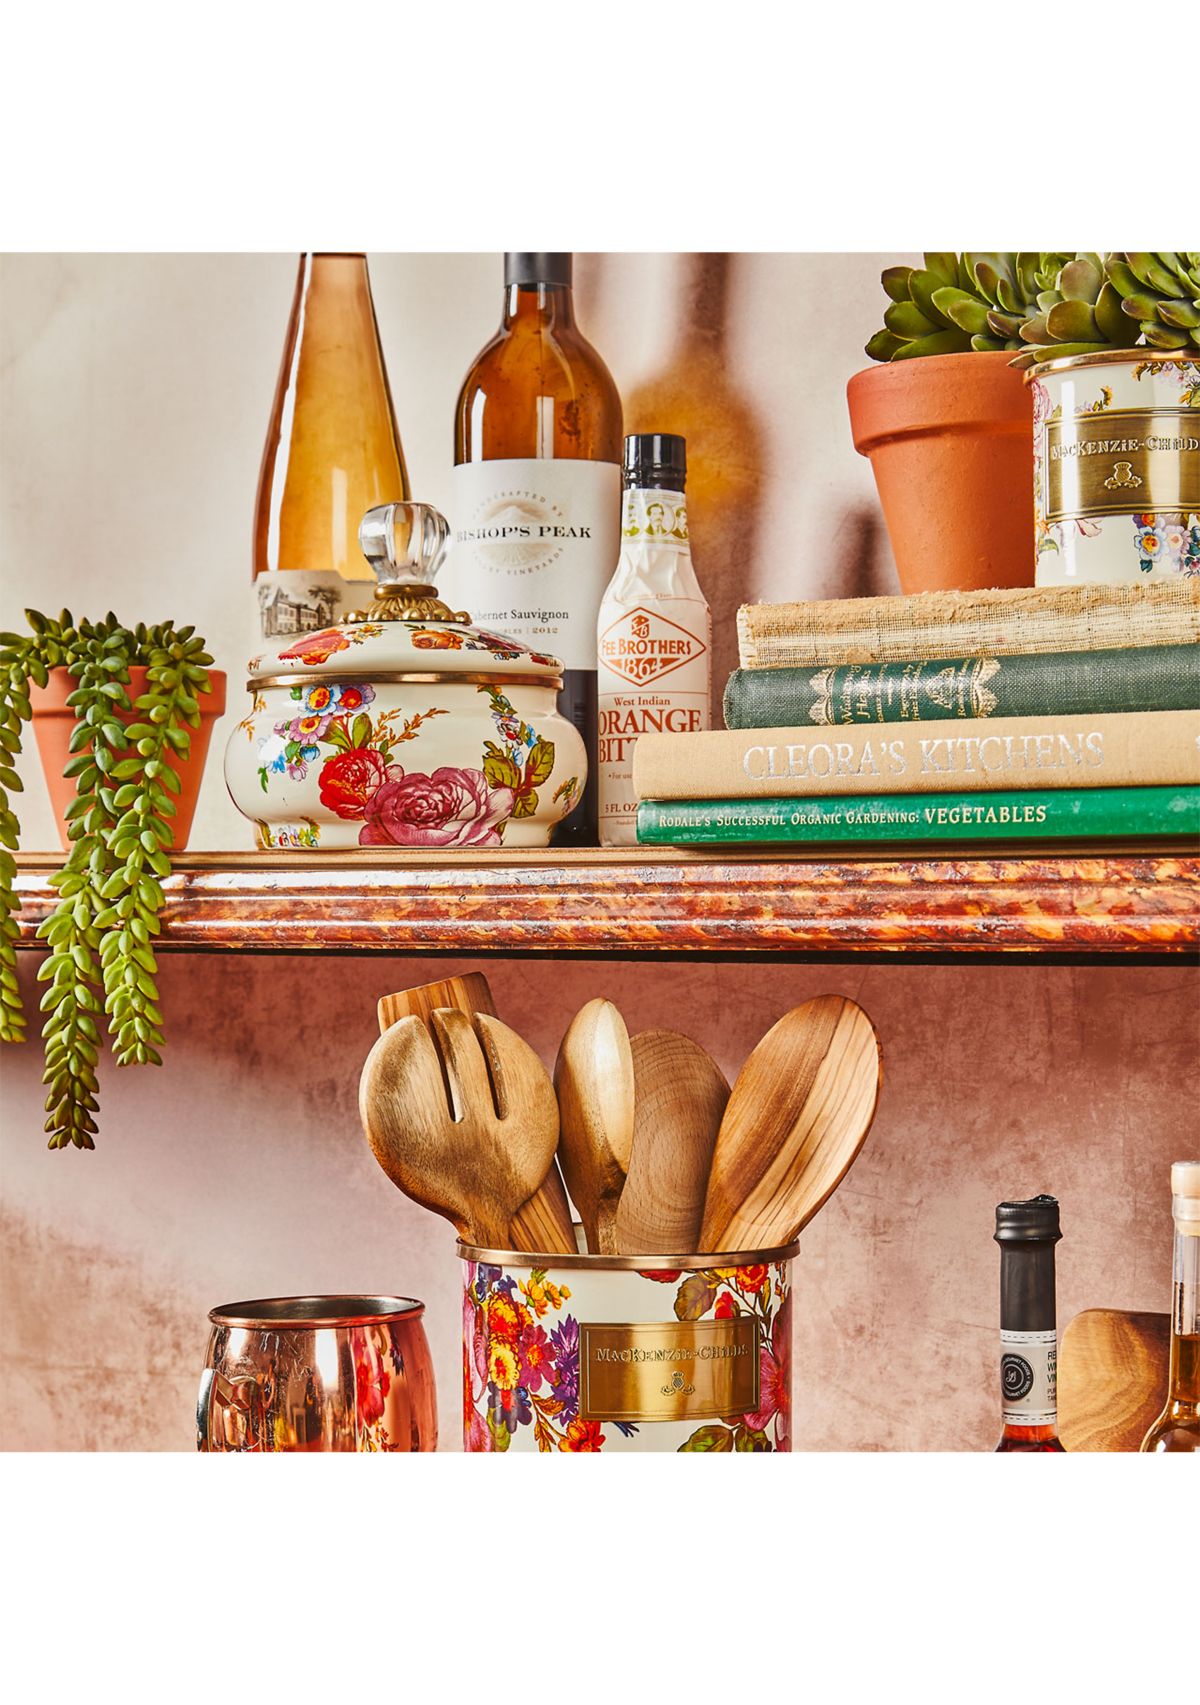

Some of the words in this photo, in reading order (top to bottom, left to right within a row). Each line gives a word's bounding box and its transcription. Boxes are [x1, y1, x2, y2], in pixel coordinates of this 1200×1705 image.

[457, 526, 530, 542] BISHOP'S
[539, 526, 592, 538] PEAK
[510, 608, 569, 623] Sauvignon
[618, 638, 692, 656] BROTHERS
[620, 657, 662, 678] 1864
[614, 696, 635, 706] West
[638, 696, 671, 705] Indian
[599, 708, 702, 736] ORANGE
[742, 741, 908, 781] CLEORA'S
[919, 732, 1106, 774] KITCHENS
[658, 815, 711, 828] RODALE'S
[716, 814, 786, 826] SUCCESSFUL
[790, 812, 842, 825] ORGANIC
[845, 811, 919, 824] GARDENING:
[924, 805, 1047, 824] VEGETABLES
